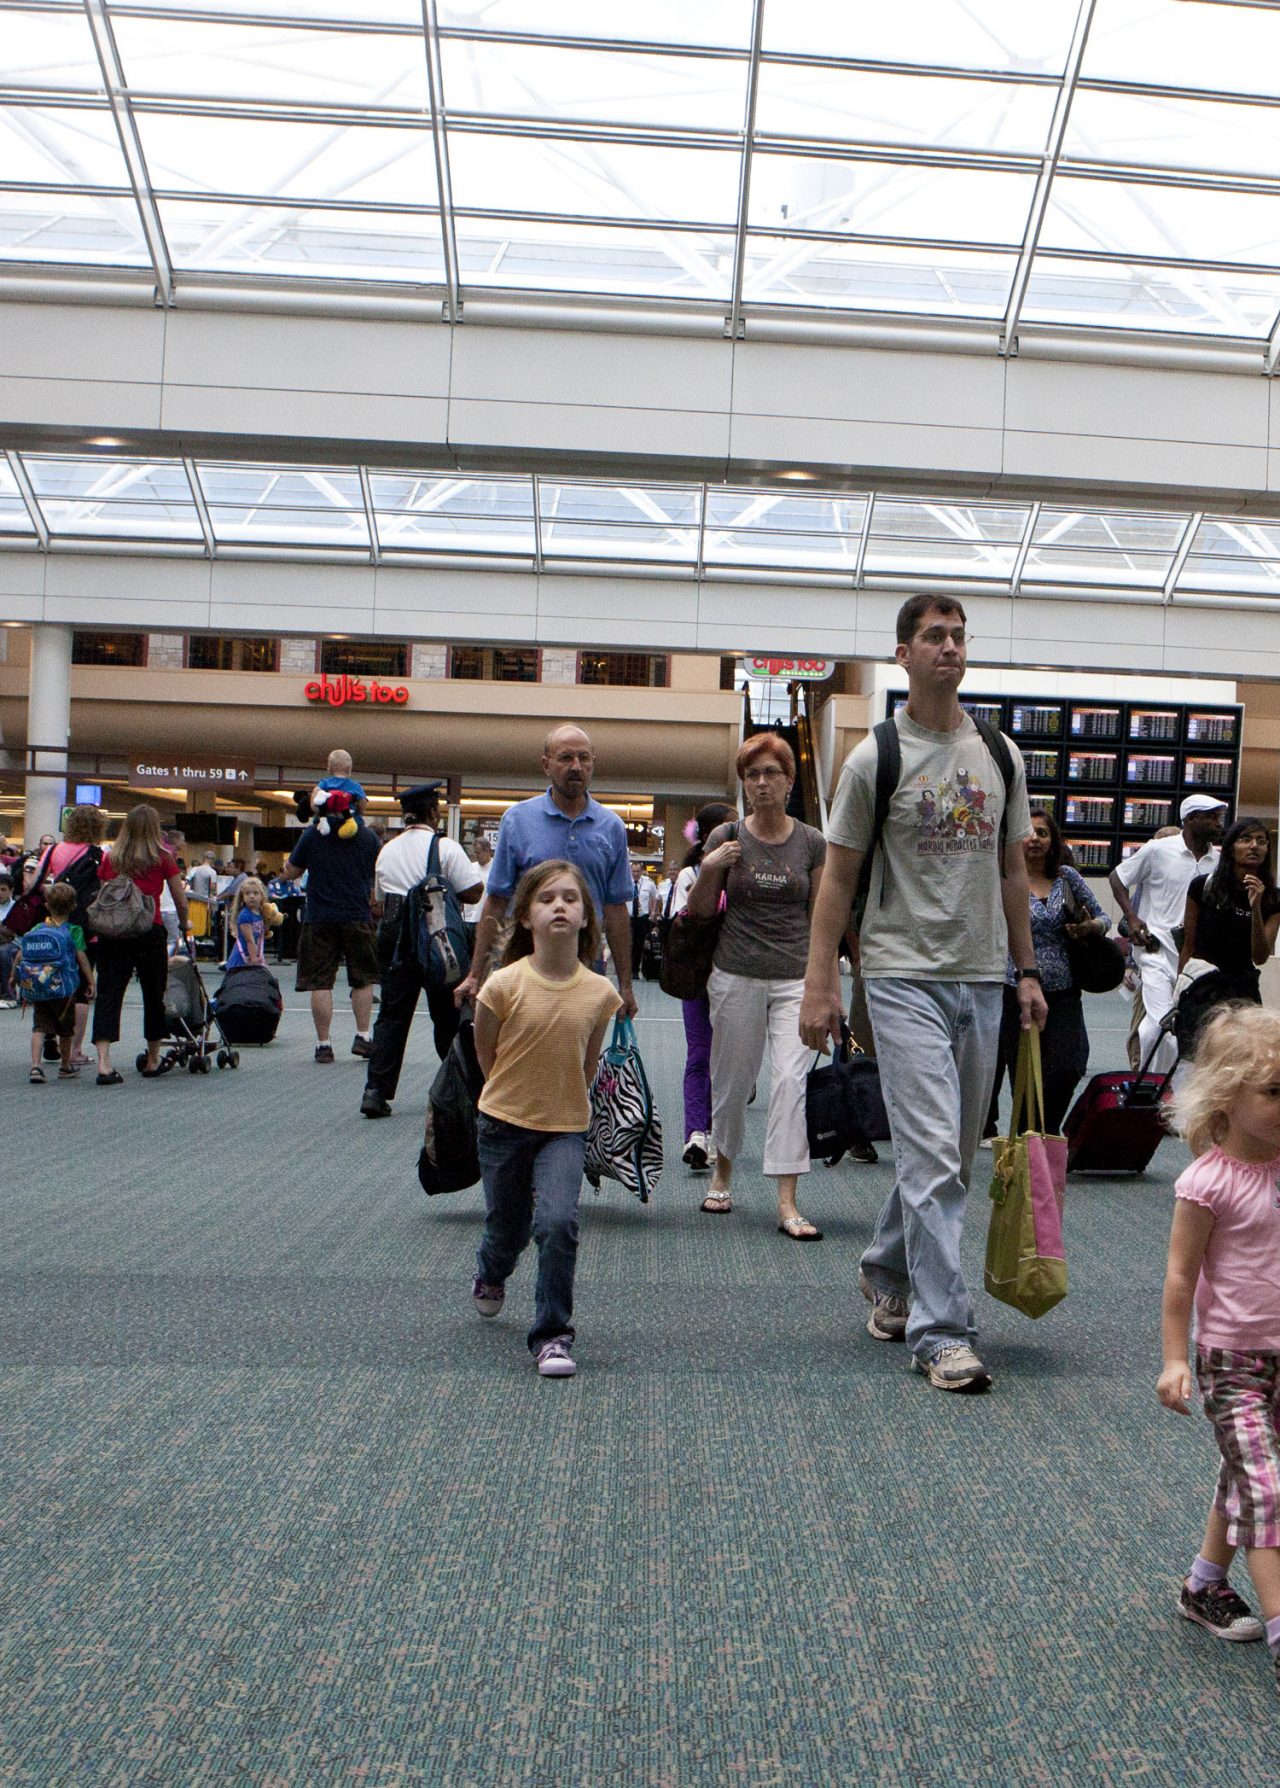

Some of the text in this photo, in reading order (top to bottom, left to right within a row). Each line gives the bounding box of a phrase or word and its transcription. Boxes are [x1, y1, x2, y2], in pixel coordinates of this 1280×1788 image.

[753, 657, 795, 675] chilis
[304, 673, 409, 707] chili's too
[136, 764, 223, 779] Gates 1 thru 59
[755, 873, 787, 884] KARMA
[26, 942, 52, 951] DIEGO
